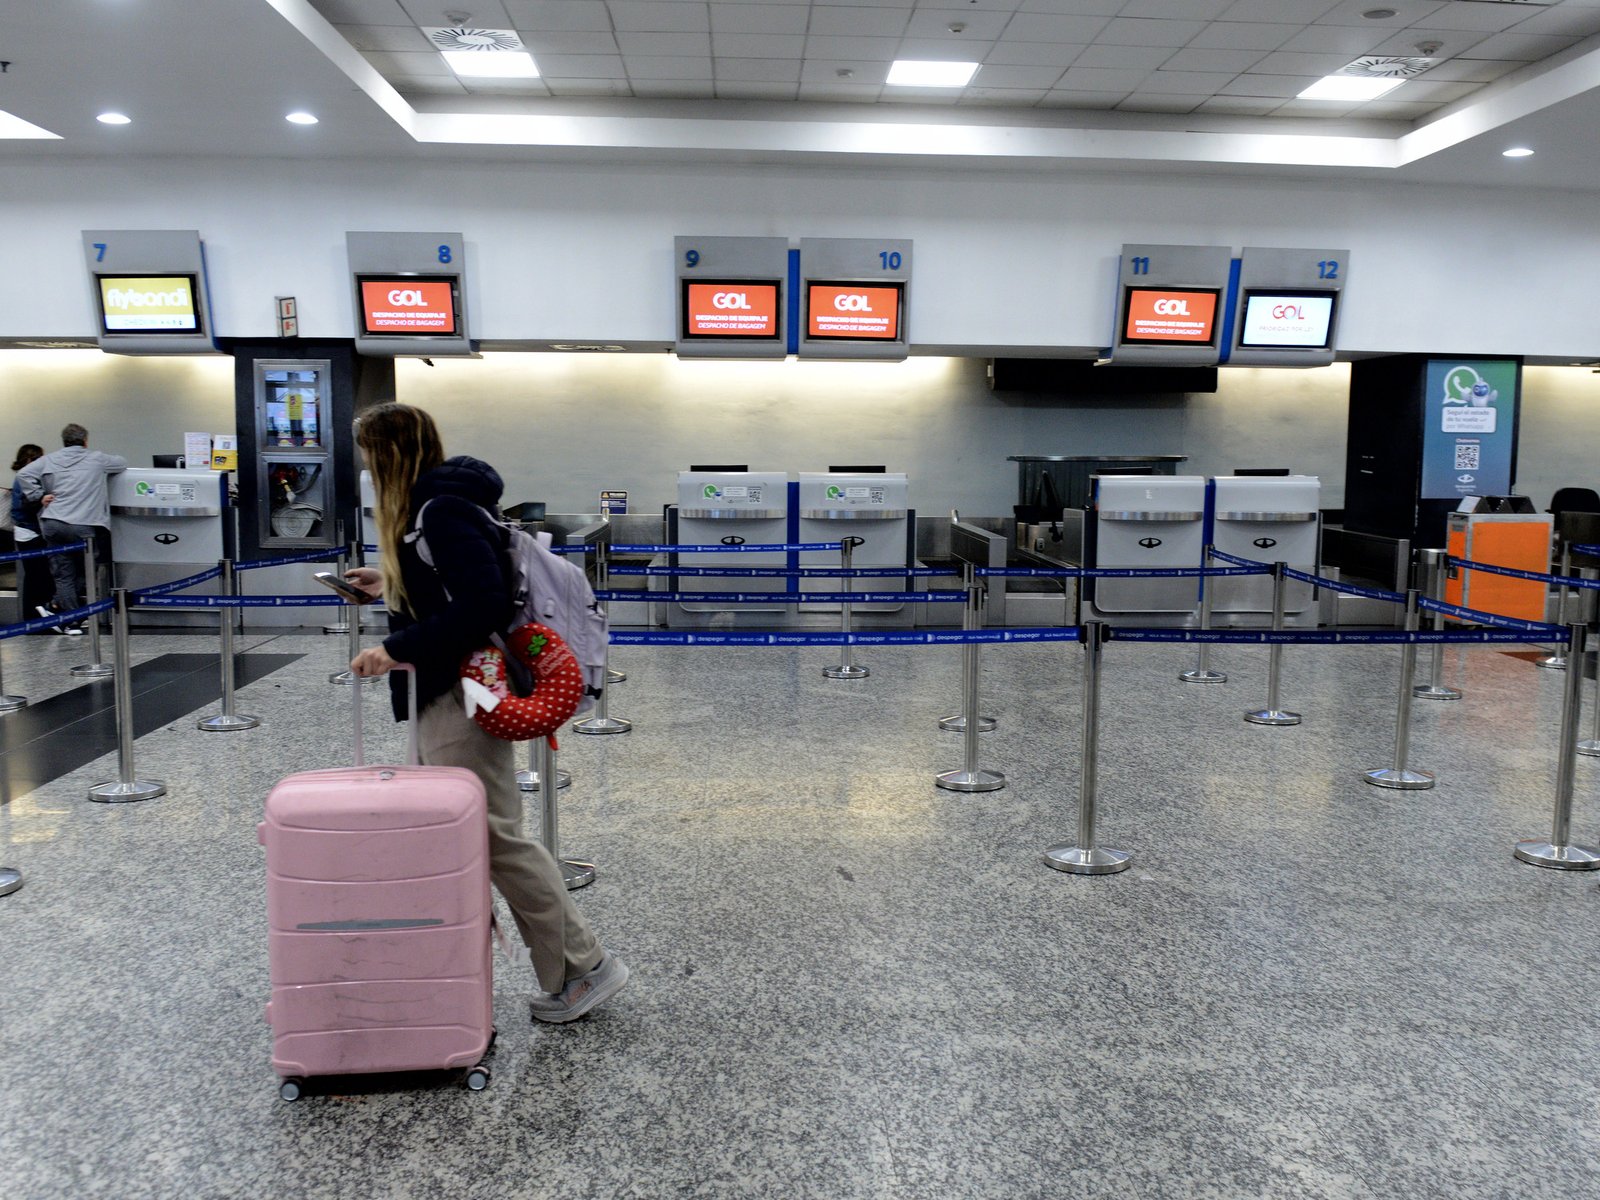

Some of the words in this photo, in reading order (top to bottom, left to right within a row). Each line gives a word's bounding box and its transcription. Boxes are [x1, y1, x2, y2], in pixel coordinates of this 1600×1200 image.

[93, 243, 107, 262] 7
[438, 245, 452, 264] 8
[686, 250, 700, 268] 9
[879, 251, 902, 270] 10
[1132, 256, 1150, 275] 11
[1317, 260, 1339, 279] 12
[388, 290, 428, 307] GOL
[712, 292, 751, 310] GOL
[834, 294, 873, 312] GOL
[1154, 299, 1191, 316] GOL
[1272, 305, 1305, 320] GOL
